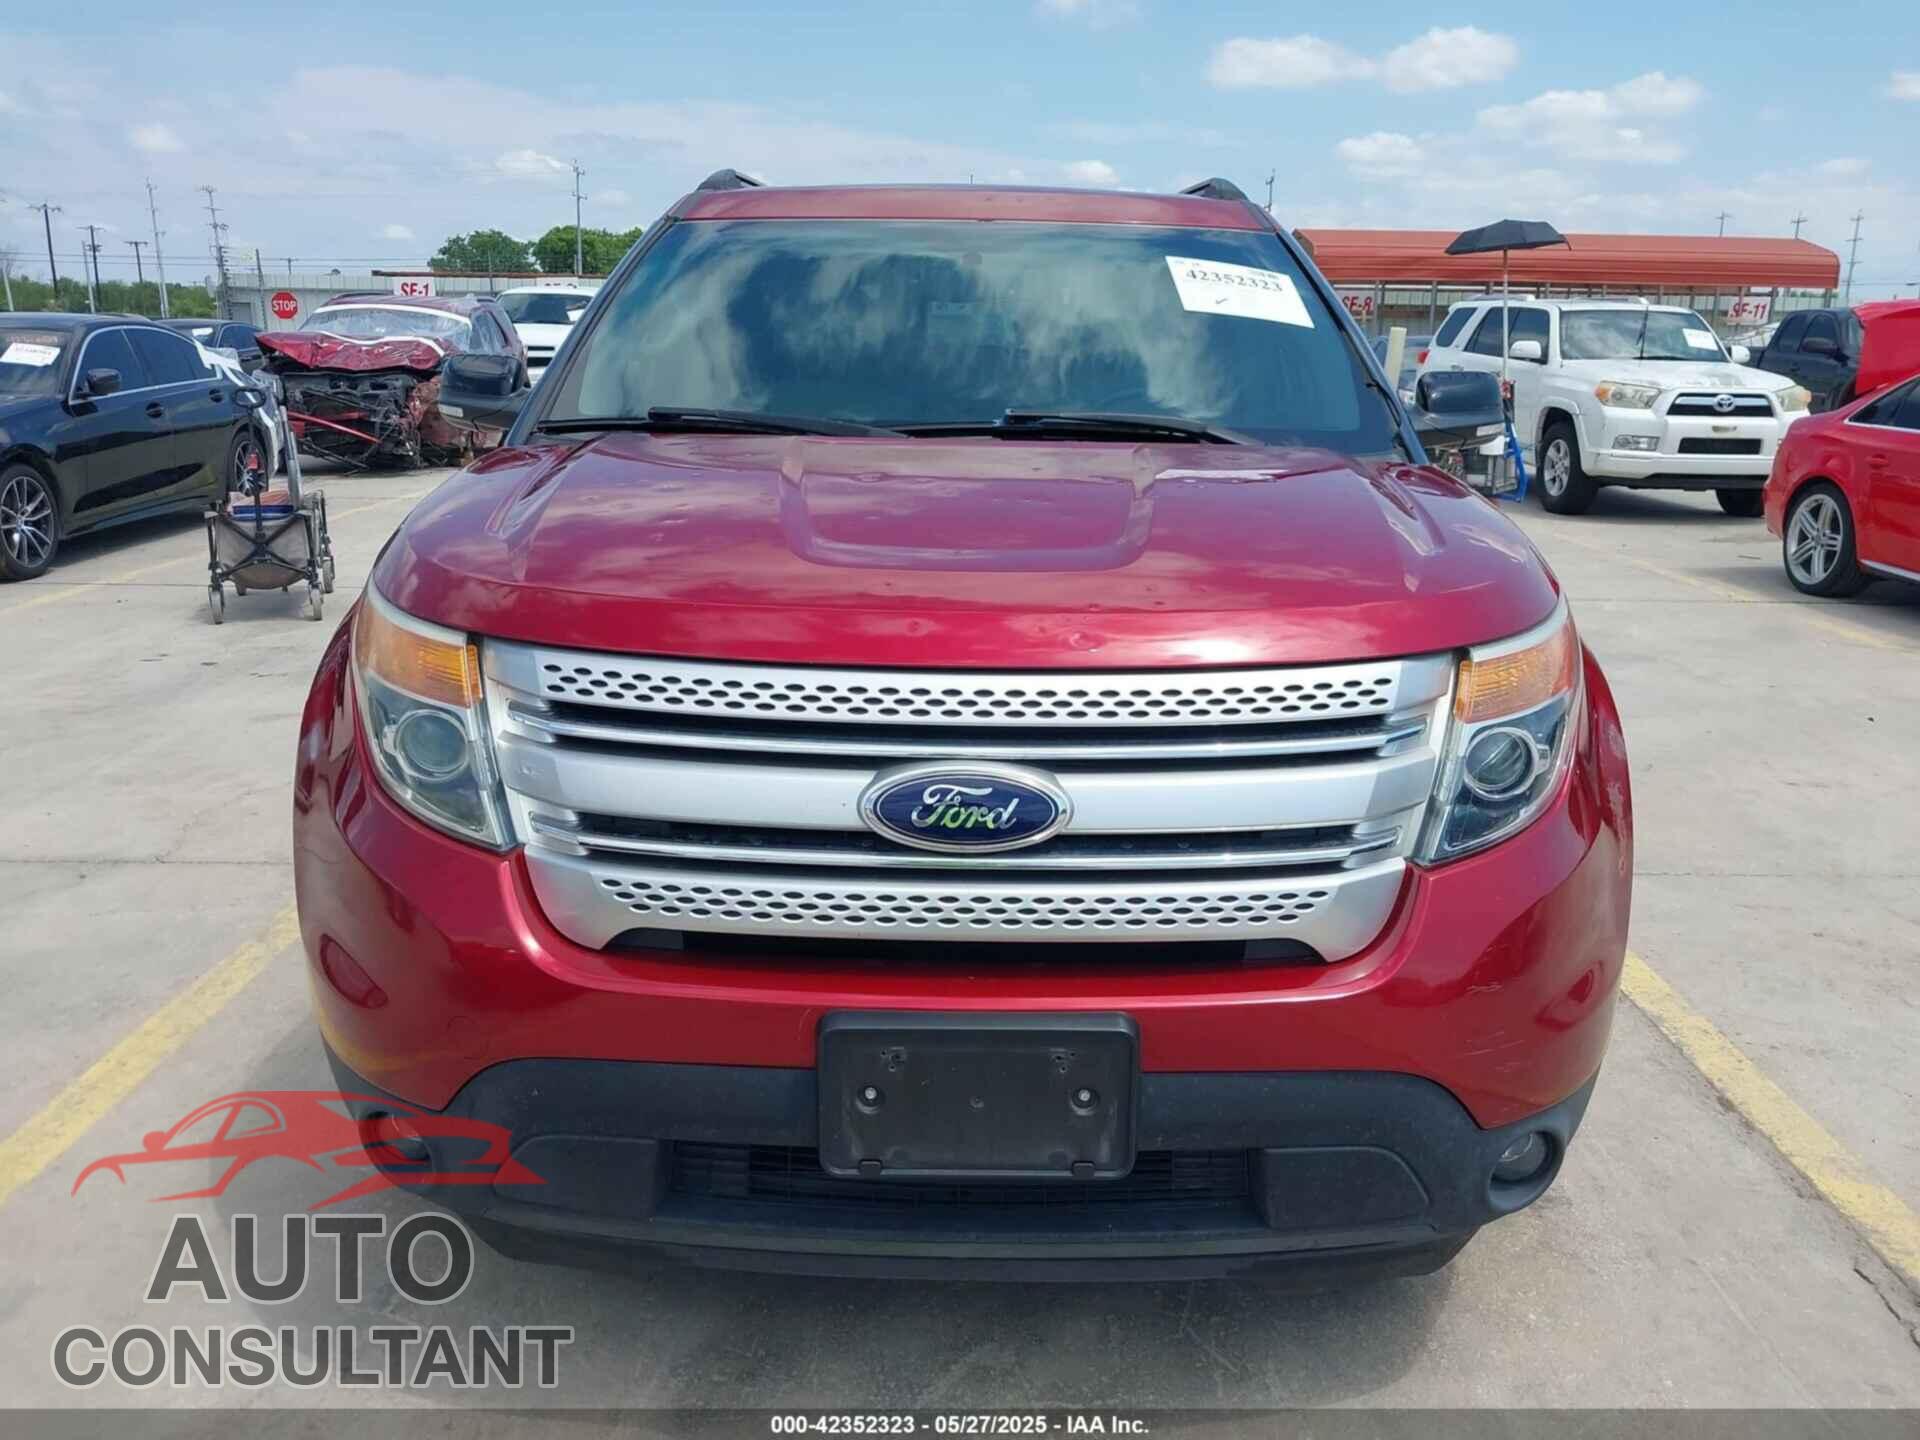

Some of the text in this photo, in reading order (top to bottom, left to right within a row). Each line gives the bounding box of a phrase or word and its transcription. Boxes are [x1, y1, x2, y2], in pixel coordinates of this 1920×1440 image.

[1186, 268, 1283, 292] 42352323
[272, 300, 297, 312] STOP
[911, 784, 1020, 830] Ford
